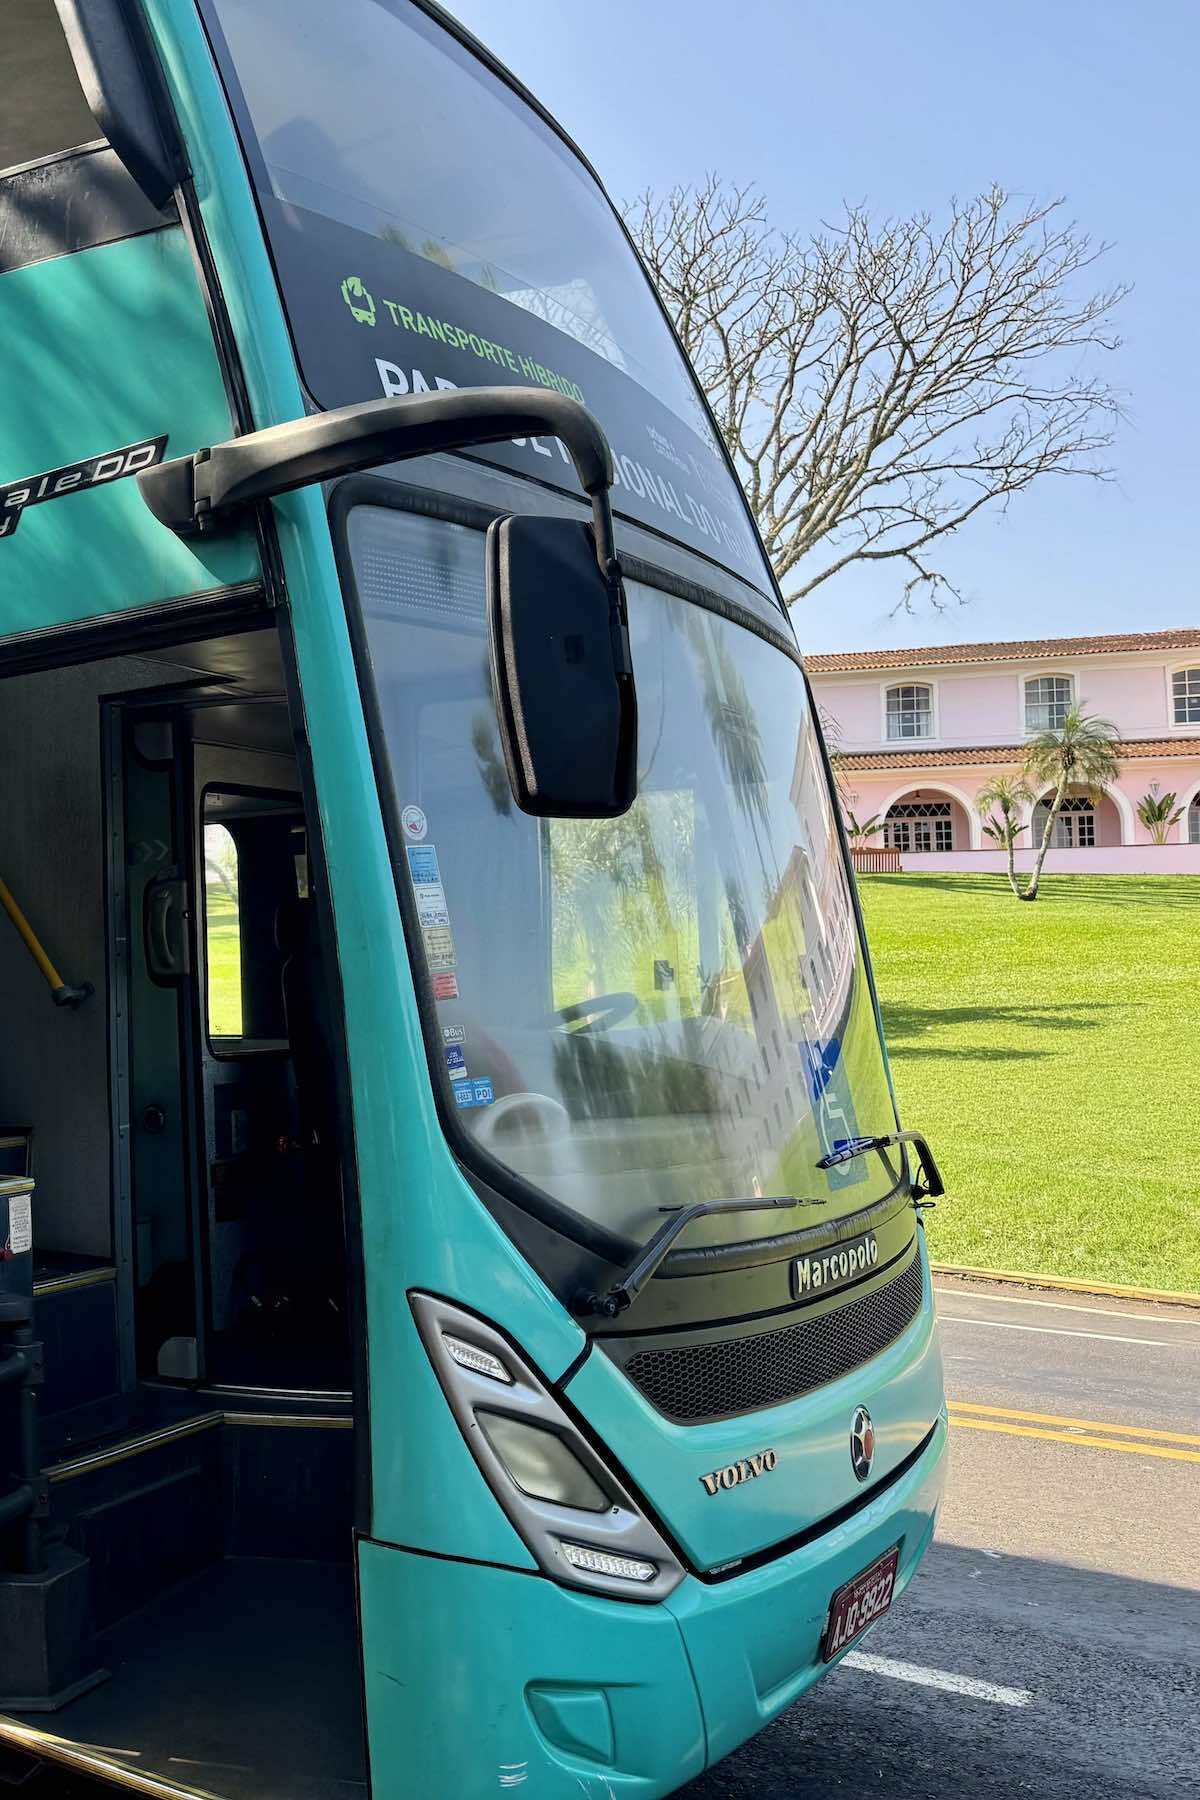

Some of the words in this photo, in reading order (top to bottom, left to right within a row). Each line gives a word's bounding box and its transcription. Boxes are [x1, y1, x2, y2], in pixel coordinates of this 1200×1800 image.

[383, 299, 519, 374] TRANSPORTE
[517, 354, 585, 405] HÍBRIDO
[91, 444, 156, 483] DD
[684, 492, 721, 545] DO
[796, 1237, 878, 1294] Marcopolo
[699, 1449, 776, 1495] VOLVO
